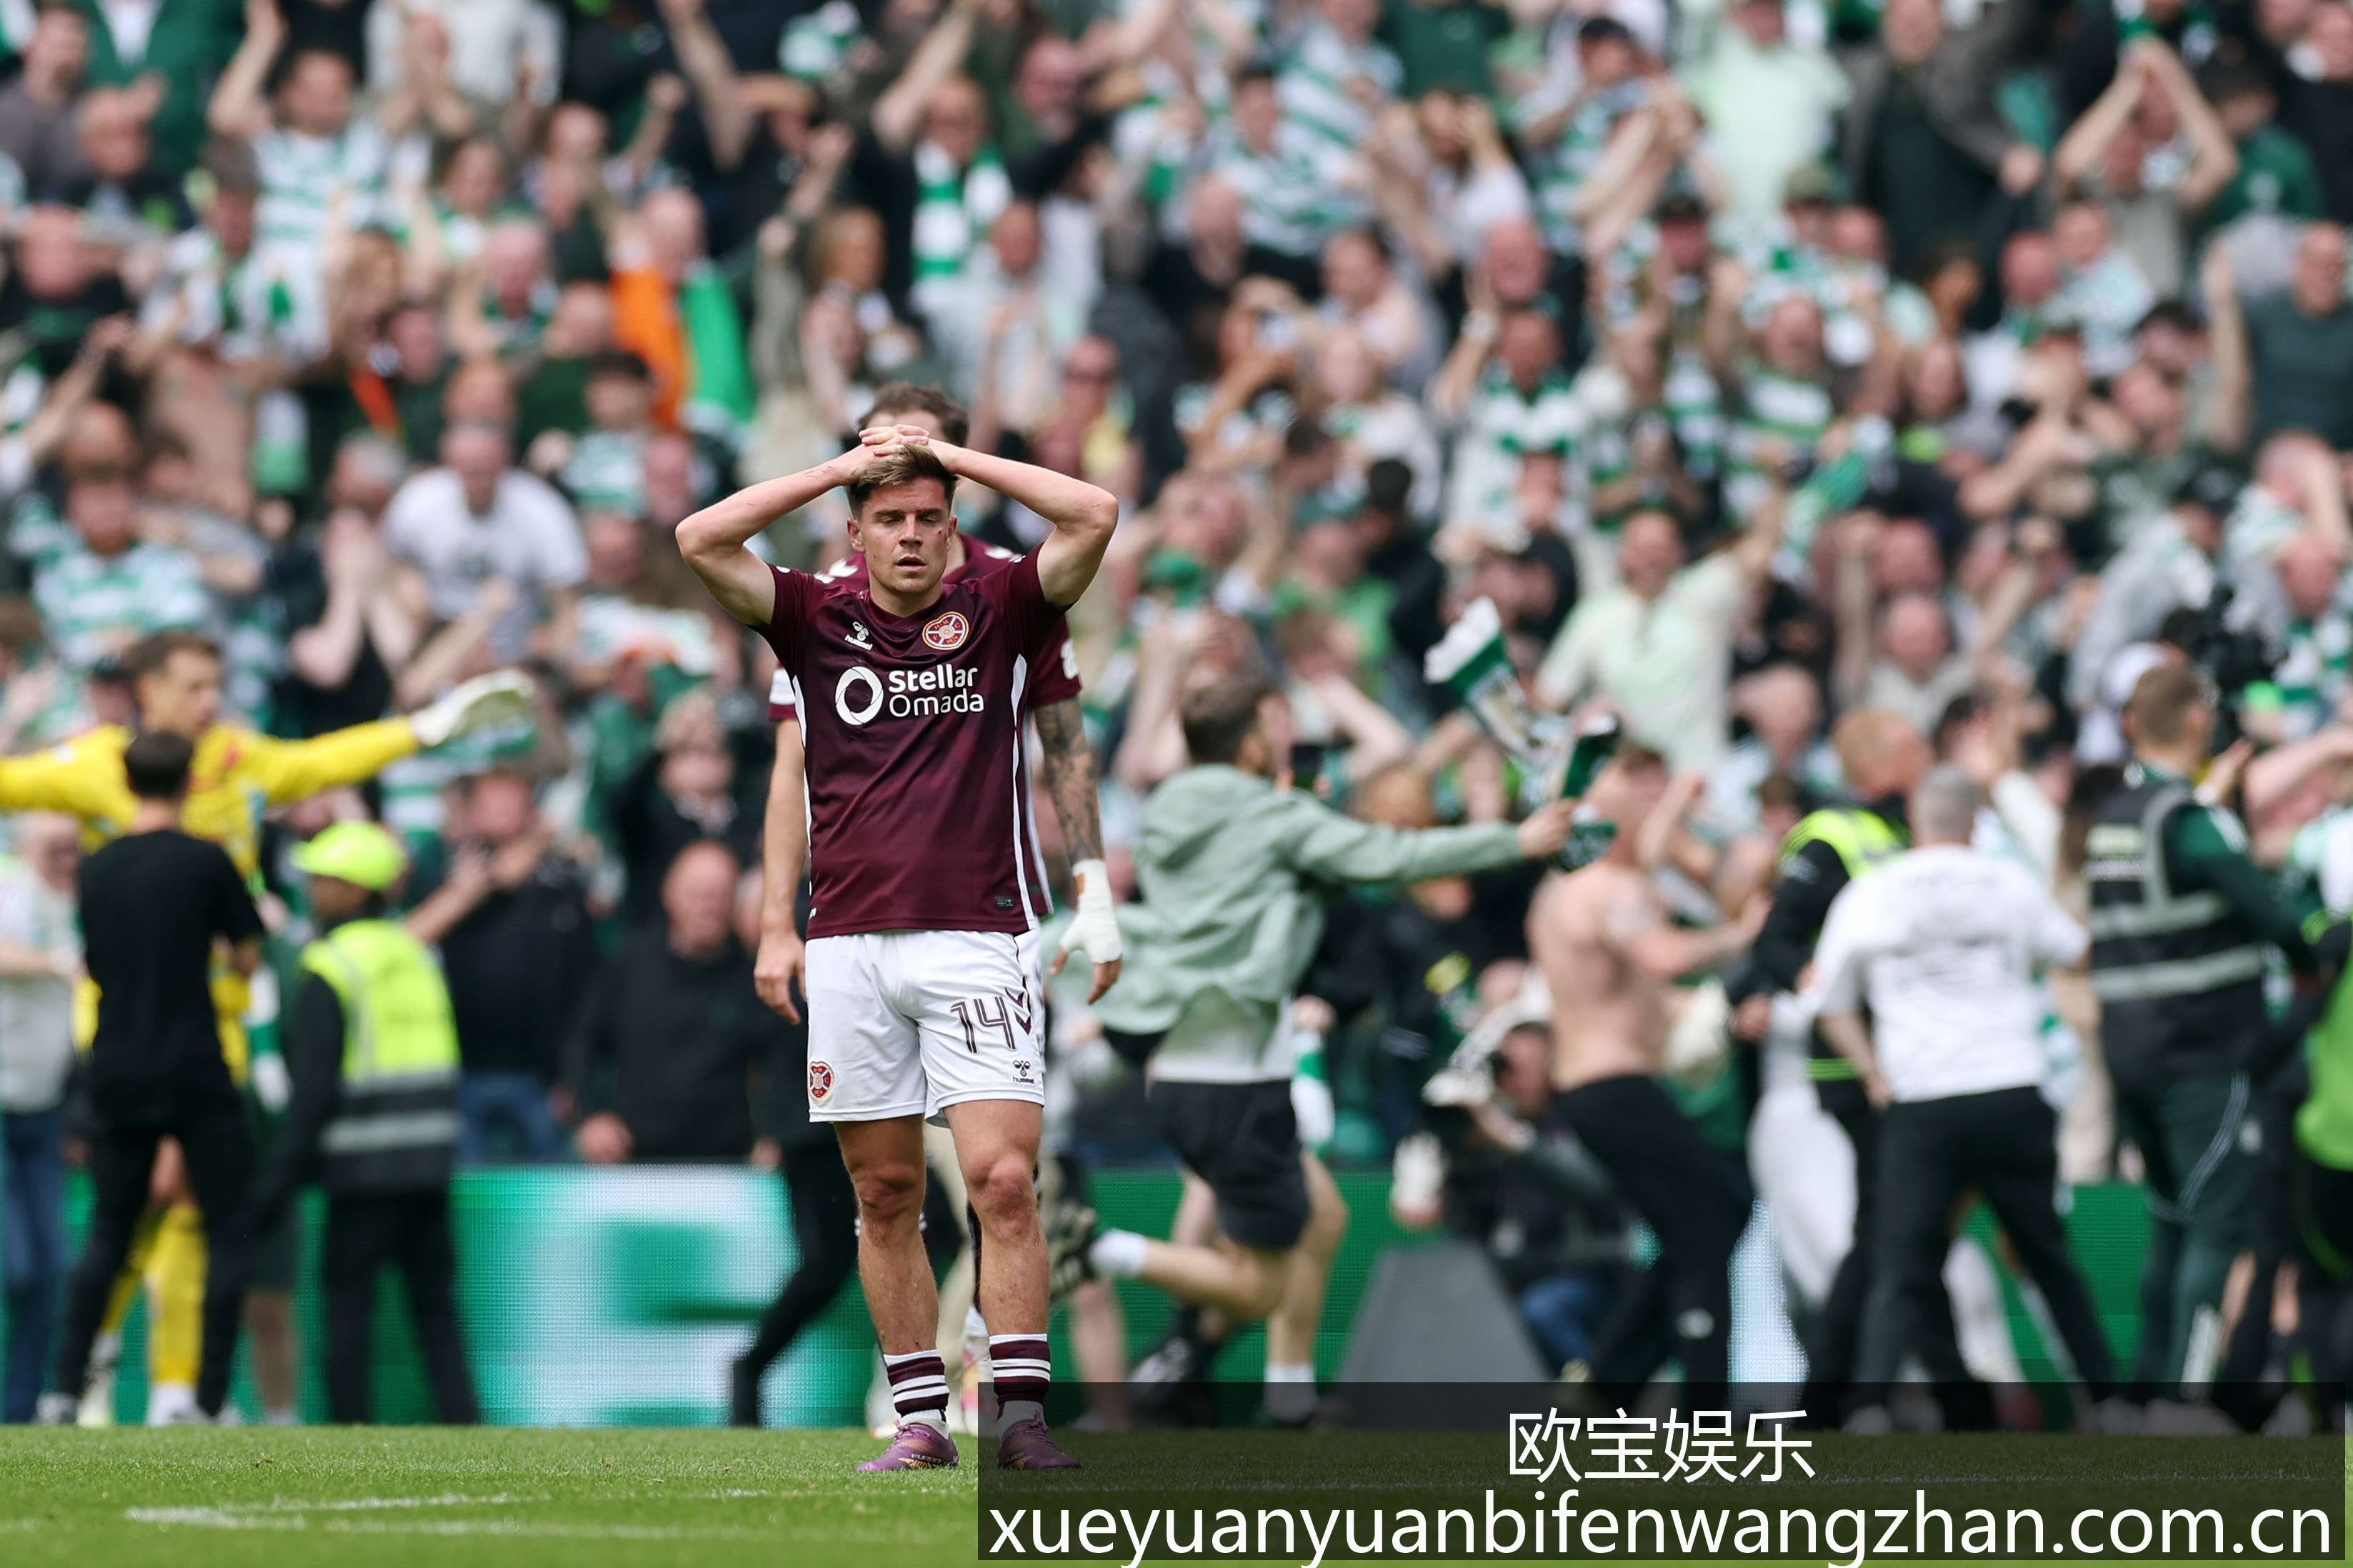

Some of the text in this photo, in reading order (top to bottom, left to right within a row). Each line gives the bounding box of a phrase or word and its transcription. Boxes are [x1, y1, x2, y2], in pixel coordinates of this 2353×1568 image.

[889, 664, 978, 693] Stellar
[889, 688, 984, 717] Omada
[949, 996, 1016, 1054] 14
